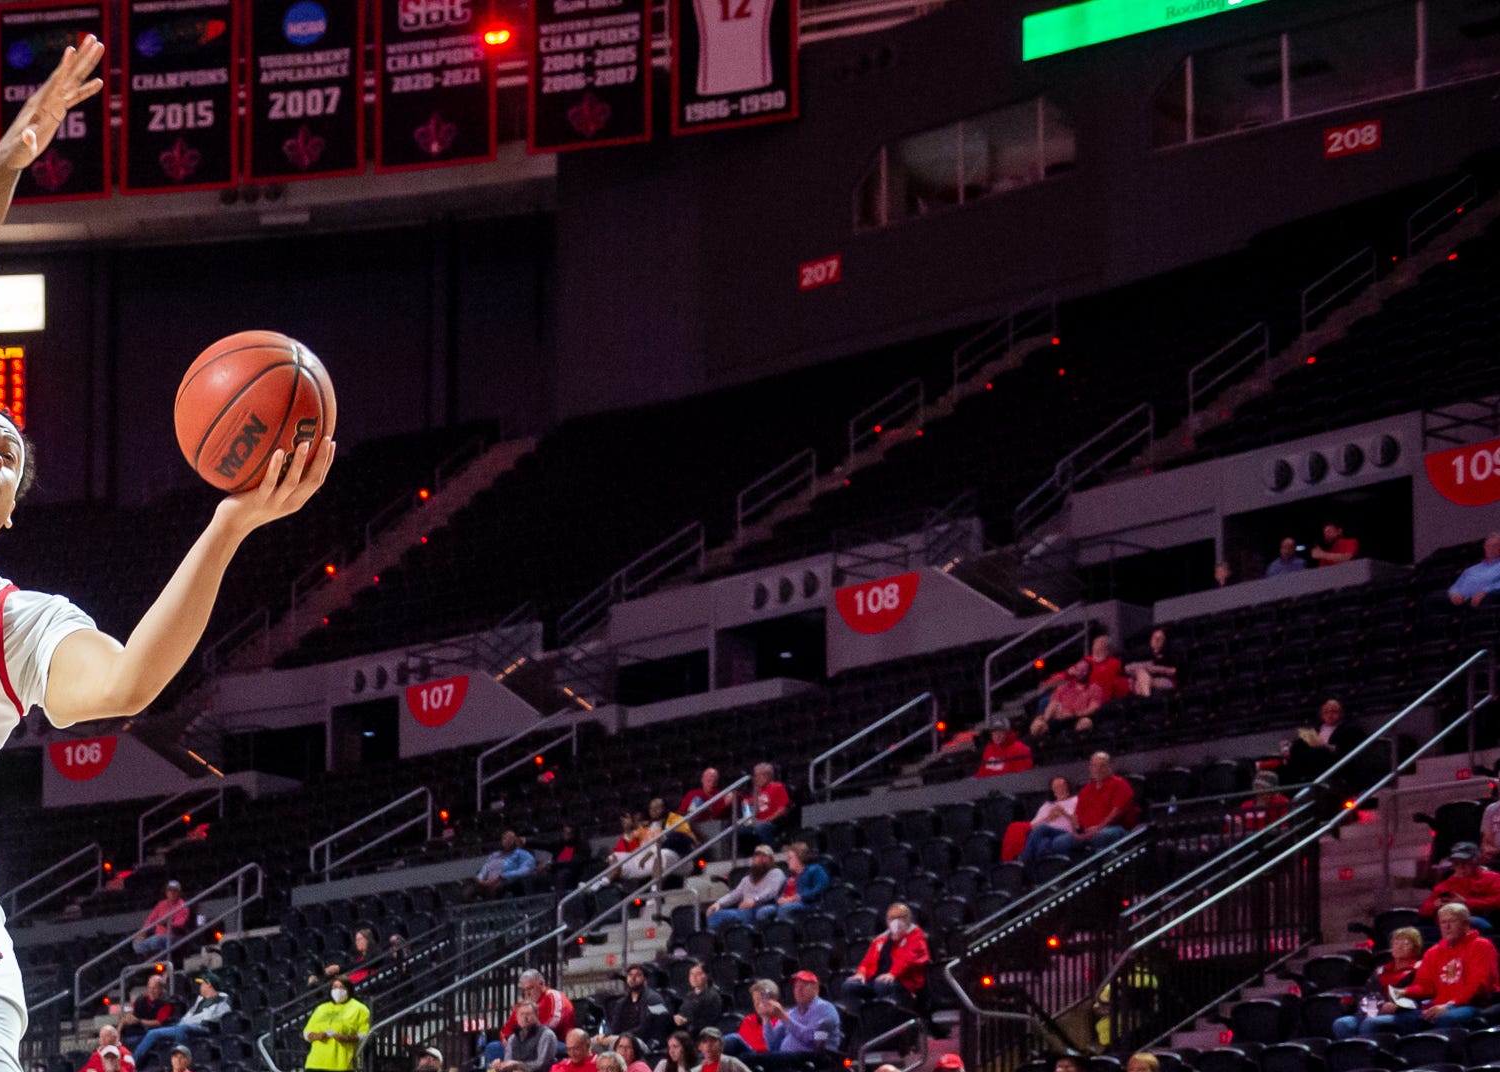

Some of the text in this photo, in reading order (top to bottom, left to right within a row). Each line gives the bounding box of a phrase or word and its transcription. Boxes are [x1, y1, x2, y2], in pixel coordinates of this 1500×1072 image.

[132, 68, 228, 91] CHAMPIONS
[148, 100, 214, 131] 2015
[268, 86, 340, 119] 2007
[57, 111, 86, 139] 16
[1326, 124, 1377, 153] 208
[801, 259, 838, 287] 207
[854, 582, 900, 616] 108
[420, 683, 454, 712] 107
[63, 742, 102, 766] 106
